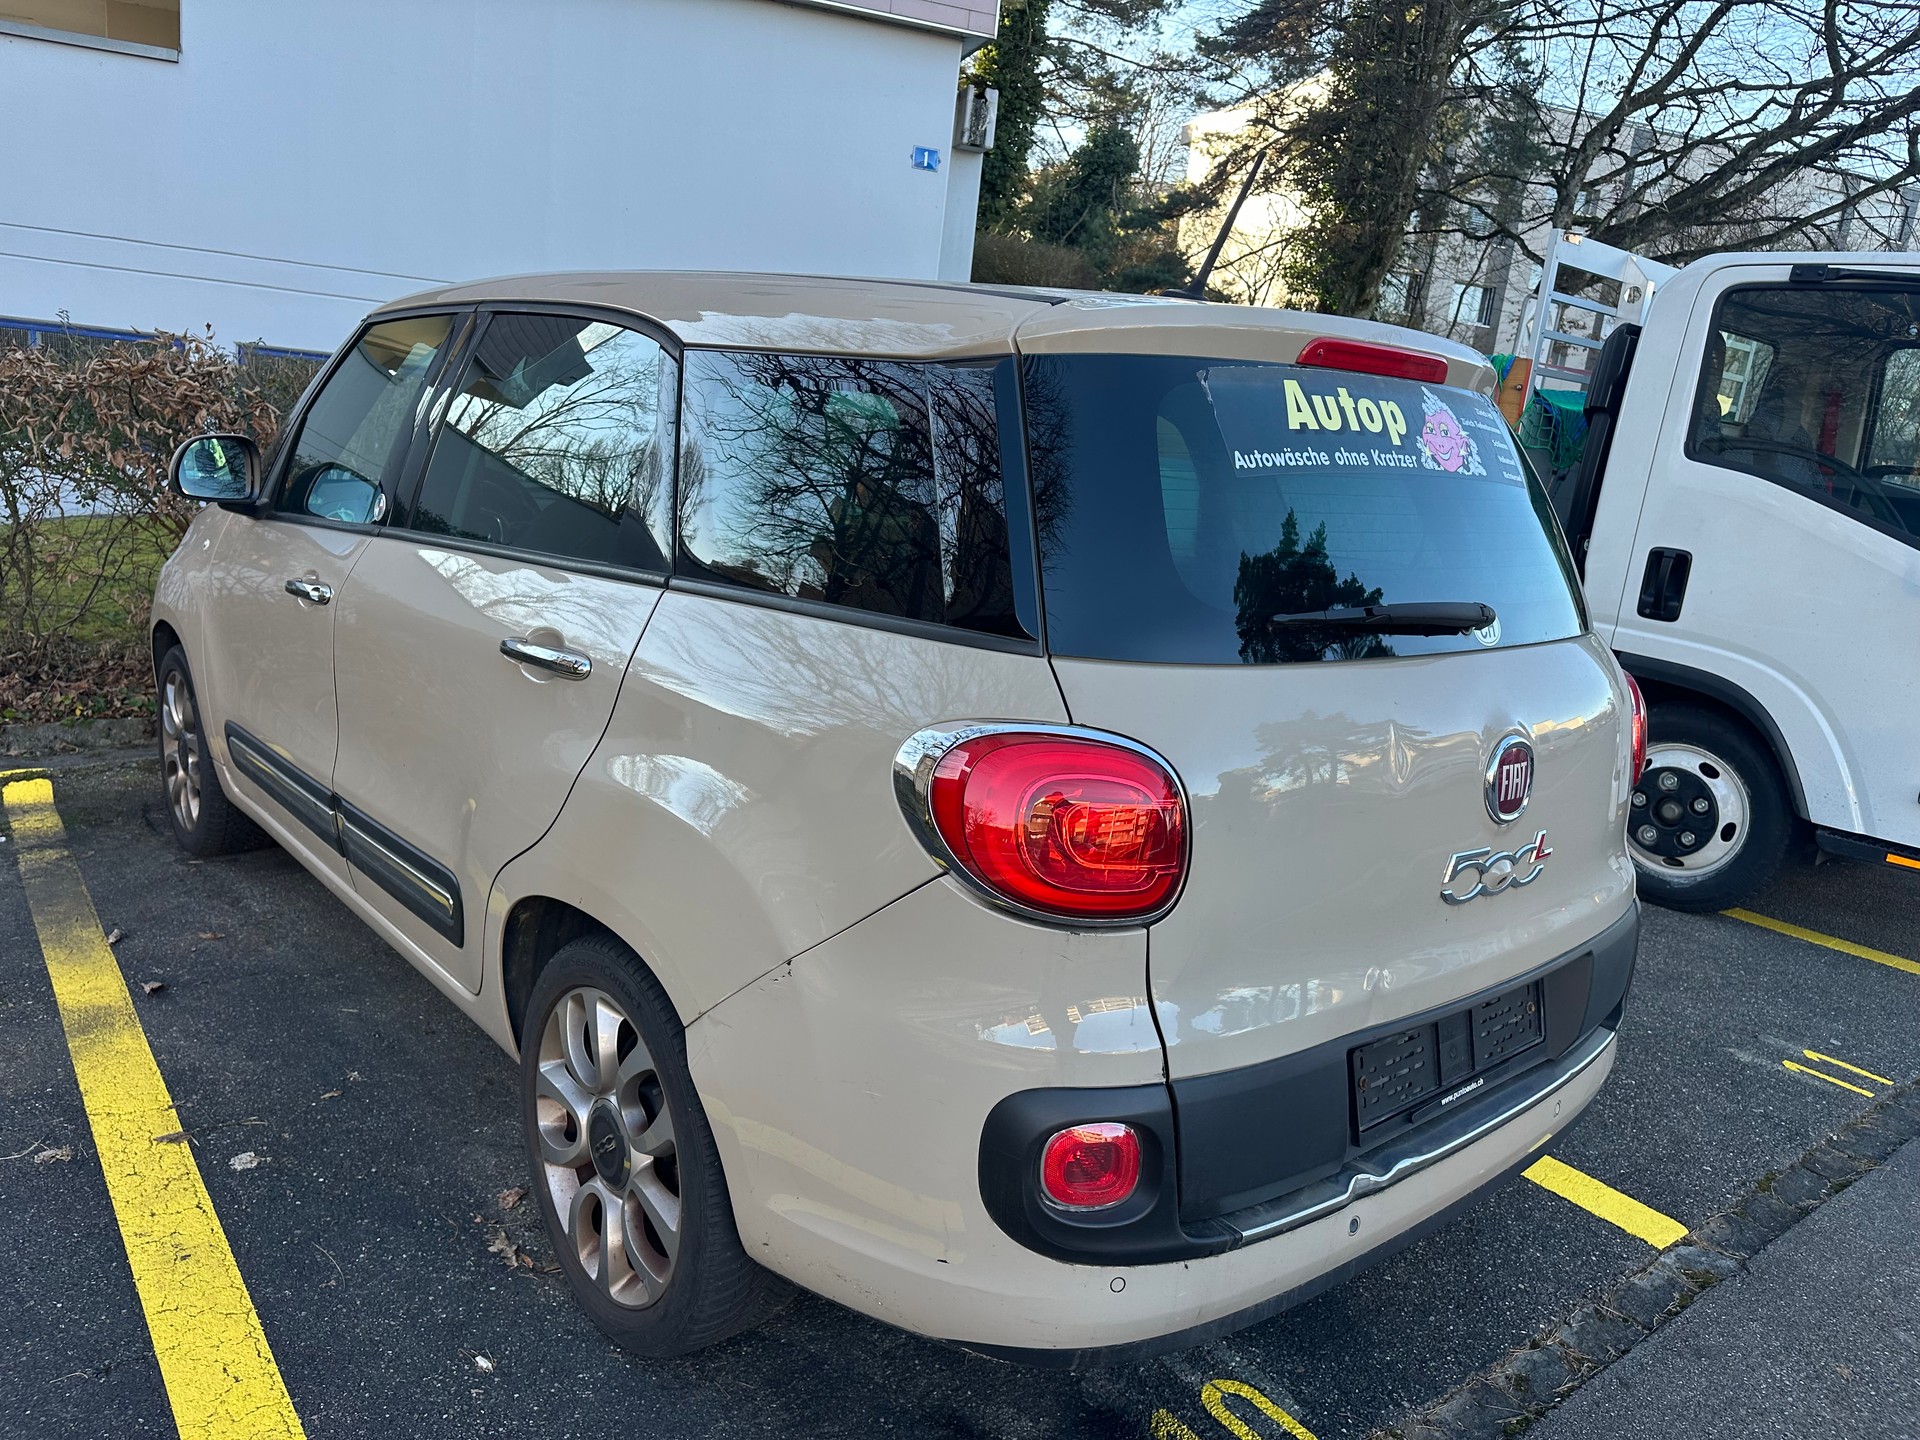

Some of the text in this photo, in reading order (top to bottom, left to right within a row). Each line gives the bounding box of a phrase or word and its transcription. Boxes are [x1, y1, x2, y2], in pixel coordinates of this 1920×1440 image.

[923, 151, 929, 167] 1
[1283, 379, 1407, 446] Autop
[1234, 447, 1419, 470] Autowäsche ohne Kratzer
[1500, 761, 1528, 802] FIAT
